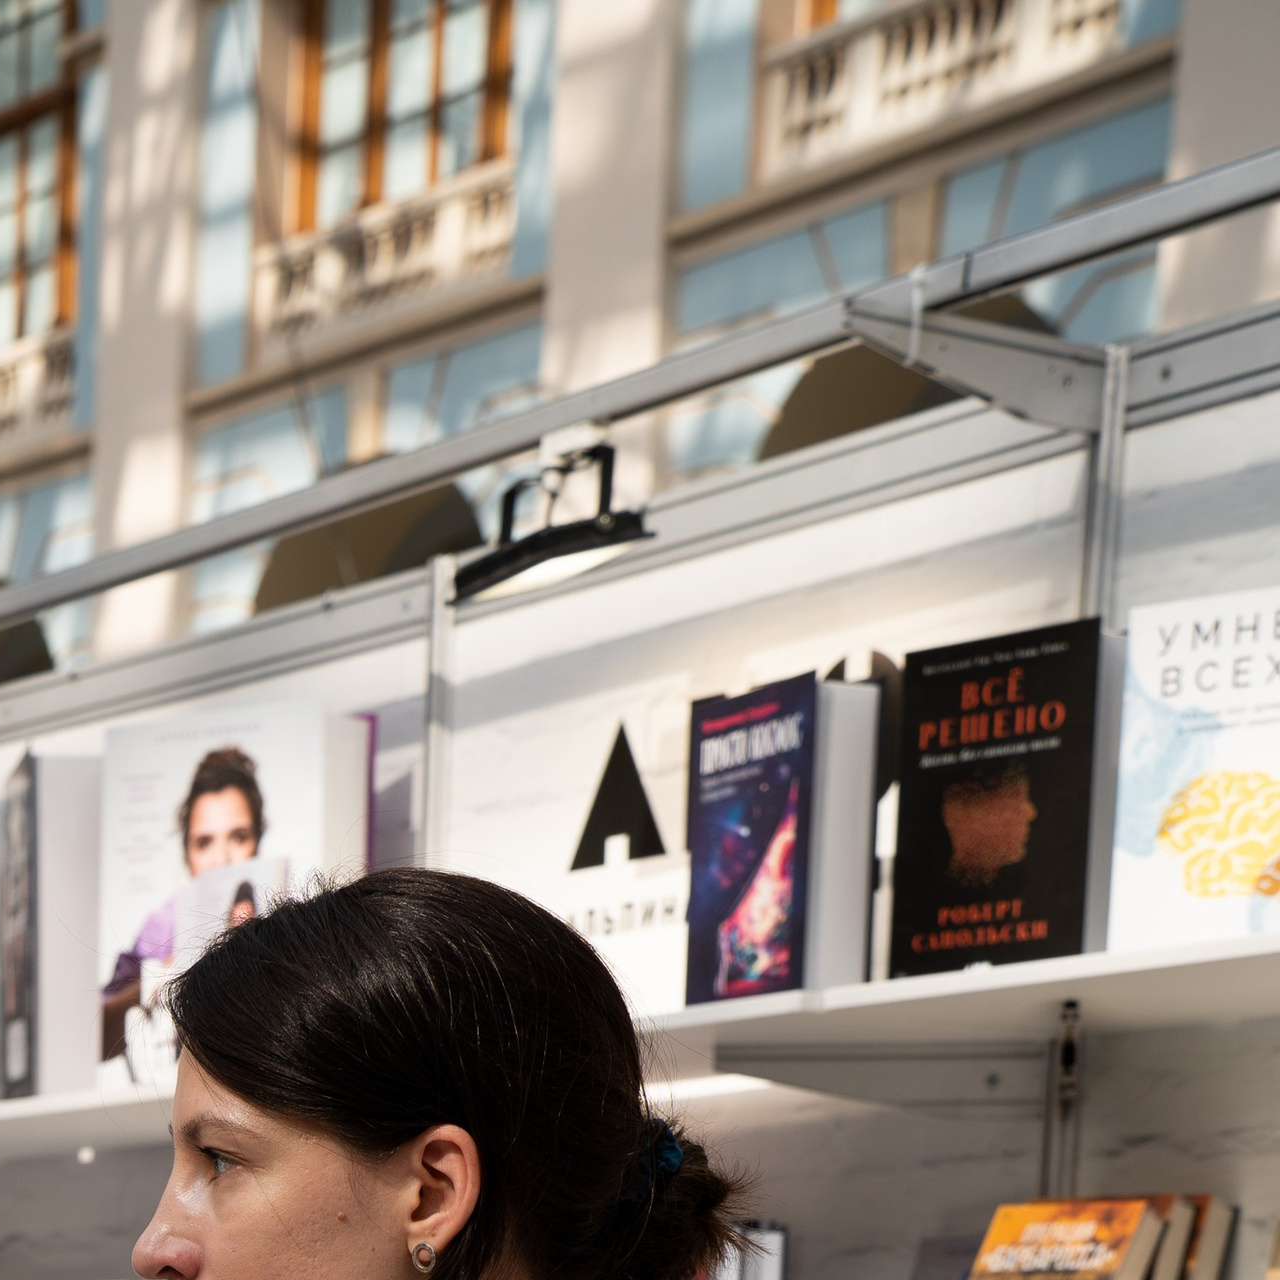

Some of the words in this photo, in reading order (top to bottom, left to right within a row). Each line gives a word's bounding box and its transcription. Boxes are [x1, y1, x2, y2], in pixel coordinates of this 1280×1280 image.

[961, 666, 1026, 711] ВСЁ
[1160, 653, 1280, 698] ВСЕХ
[918, 701, 1067, 750] РЕШЕНО
[568, 896, 687, 937] ЛЬПИН
[937, 898, 1023, 927] РОБЕРТ
[911, 919, 1048, 952] САПОЛЬСКИ
